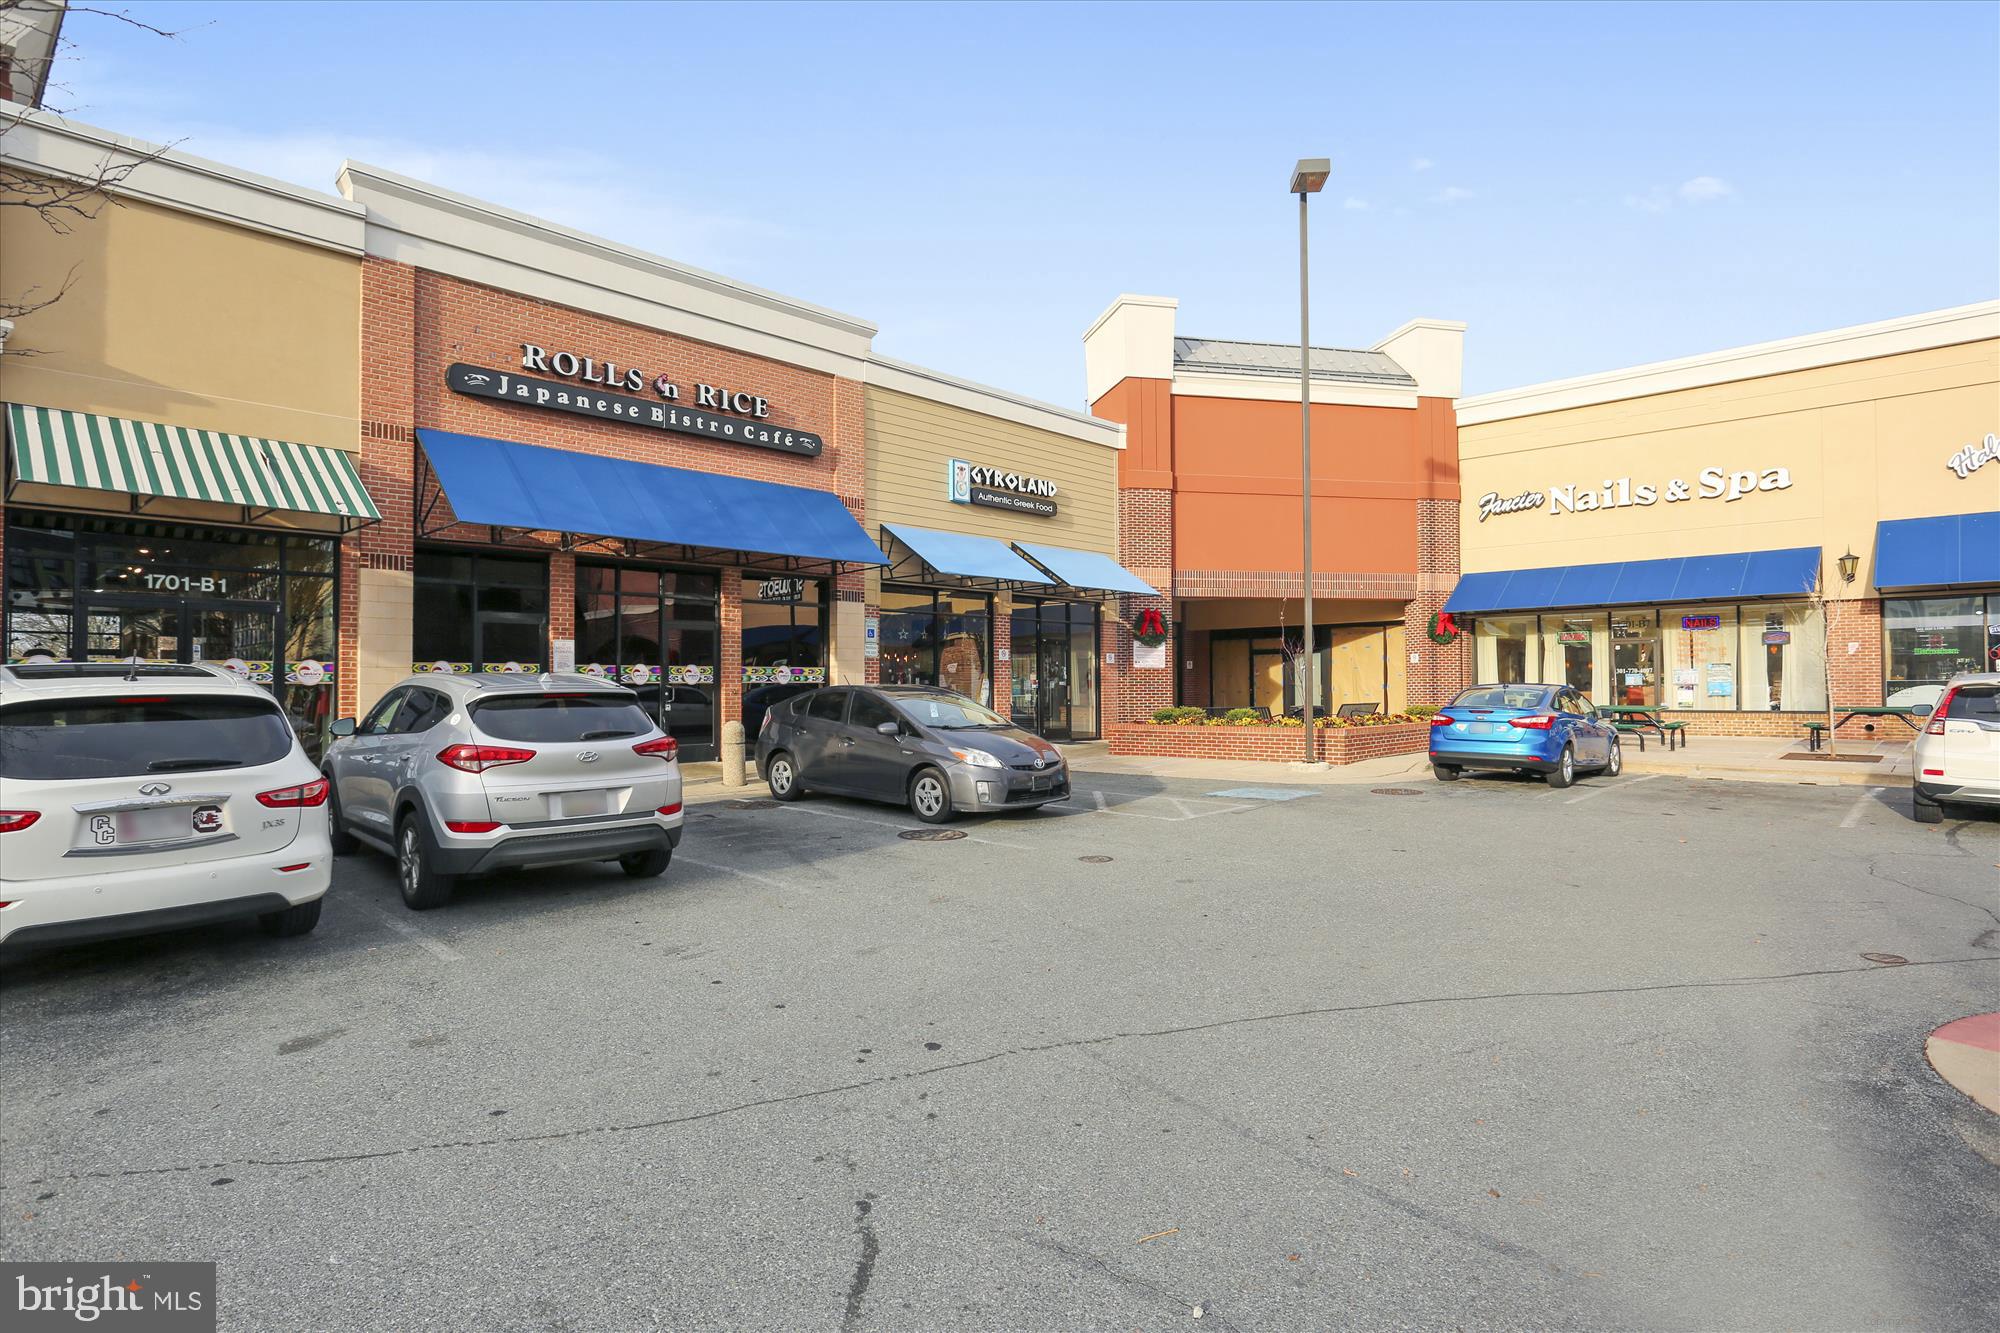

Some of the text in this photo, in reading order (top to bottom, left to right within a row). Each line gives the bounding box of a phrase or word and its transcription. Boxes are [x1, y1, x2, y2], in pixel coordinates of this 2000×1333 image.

[523, 343, 643, 391] ROLLS
[695, 383, 770, 418] RICE
[498, 375, 793, 446] Japanese Bistro Café
[970, 466, 1057, 497] GYROLAND
[978, 492, 1053, 512] Authentic Greek Food
[1479, 465, 1793, 522] Fancier Nails & Spa
[1686, 618, 1717, 629] NAILS
